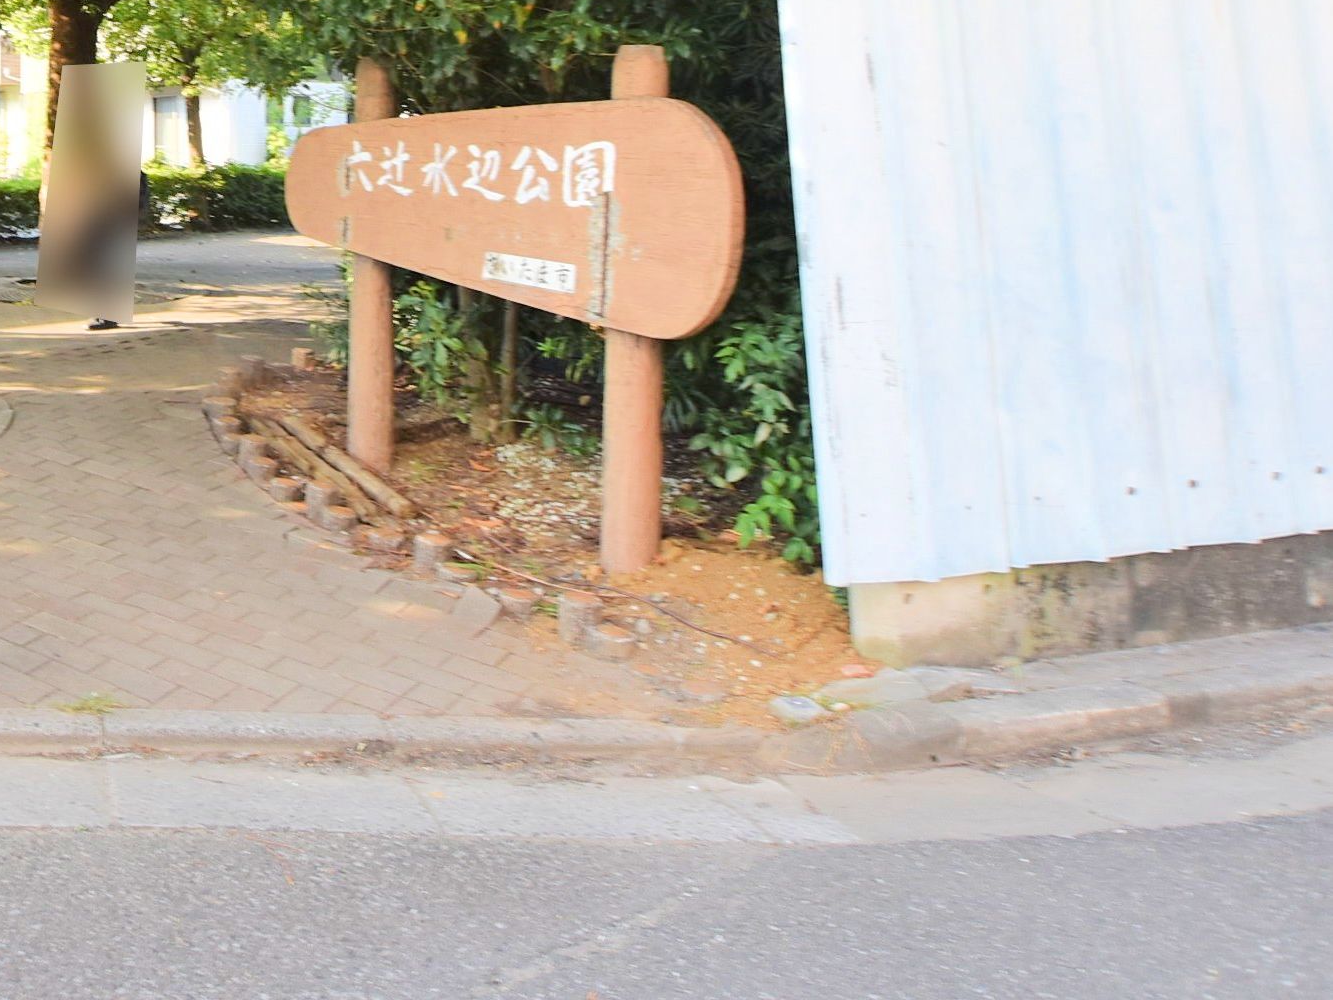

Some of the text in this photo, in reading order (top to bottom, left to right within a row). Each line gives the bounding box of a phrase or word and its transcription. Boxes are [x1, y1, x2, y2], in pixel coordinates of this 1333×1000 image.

[348, 140, 614, 207] 六辻水辺公園
